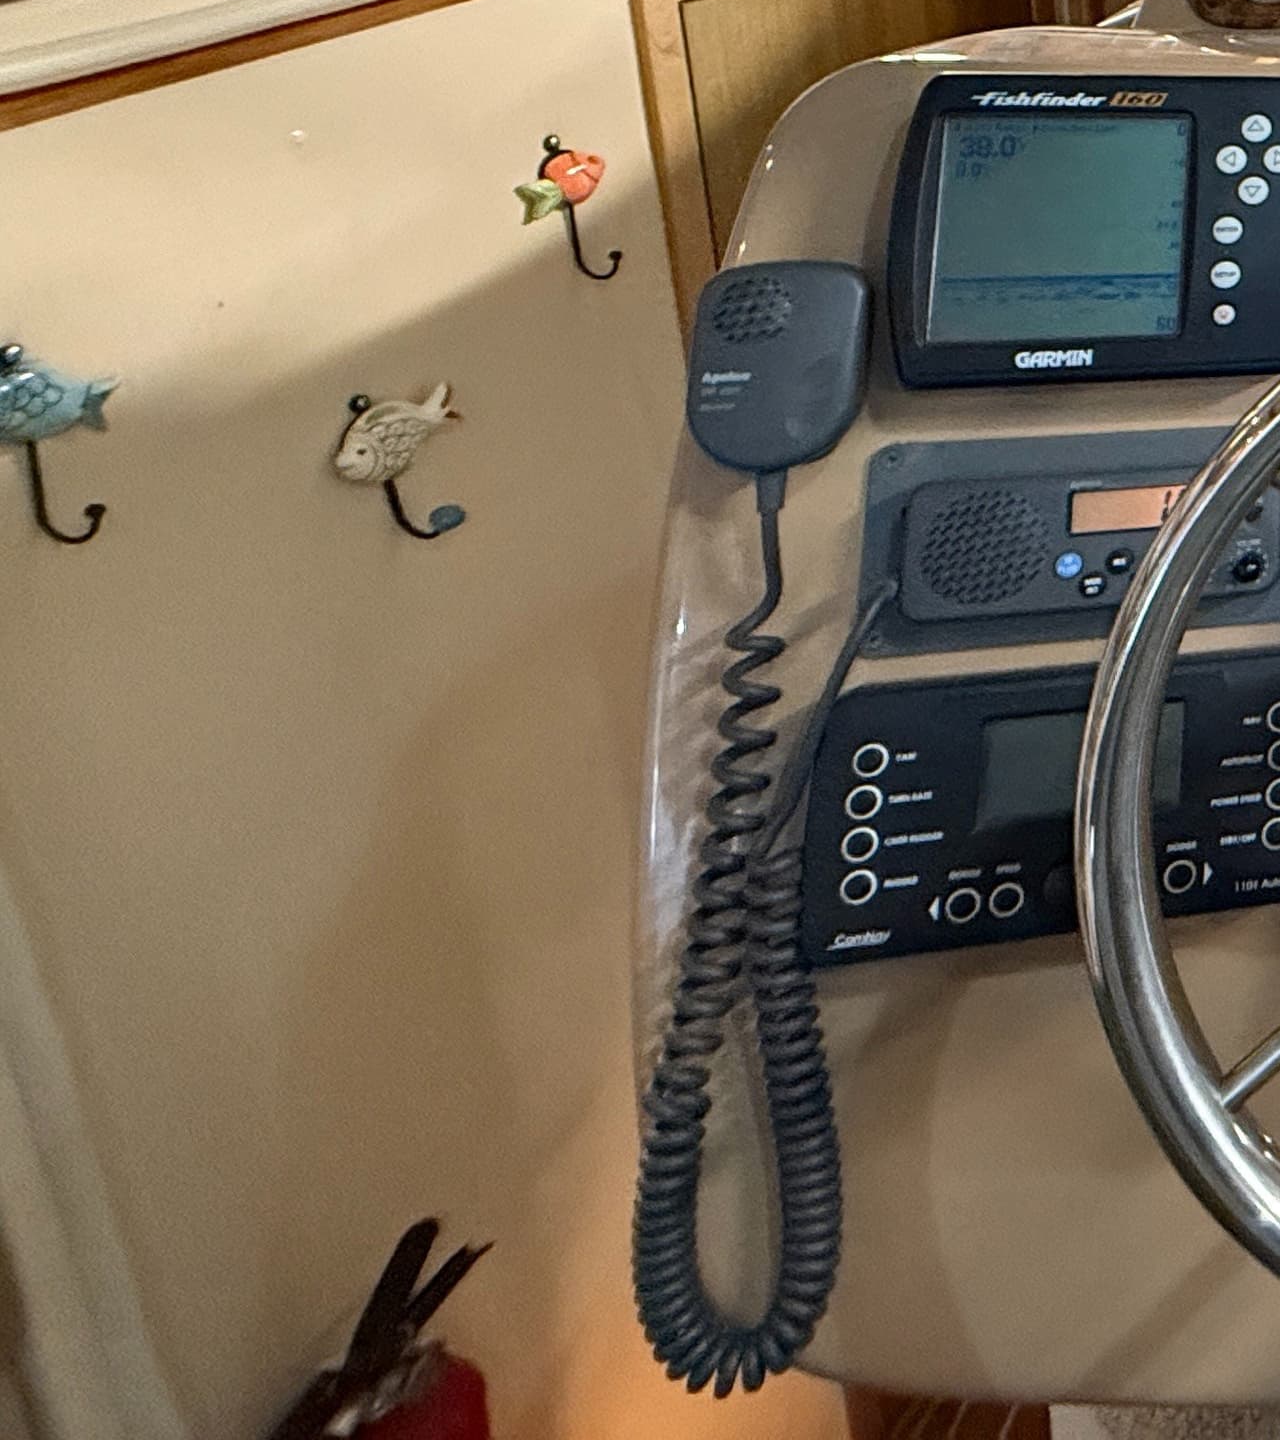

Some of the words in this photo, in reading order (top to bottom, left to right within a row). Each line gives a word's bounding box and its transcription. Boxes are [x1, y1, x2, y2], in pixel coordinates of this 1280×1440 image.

[970, 90, 1108, 108] fishfinder
[1110, 91, 1168, 108] 160
[1014, 348, 1094, 369] GARMIN
